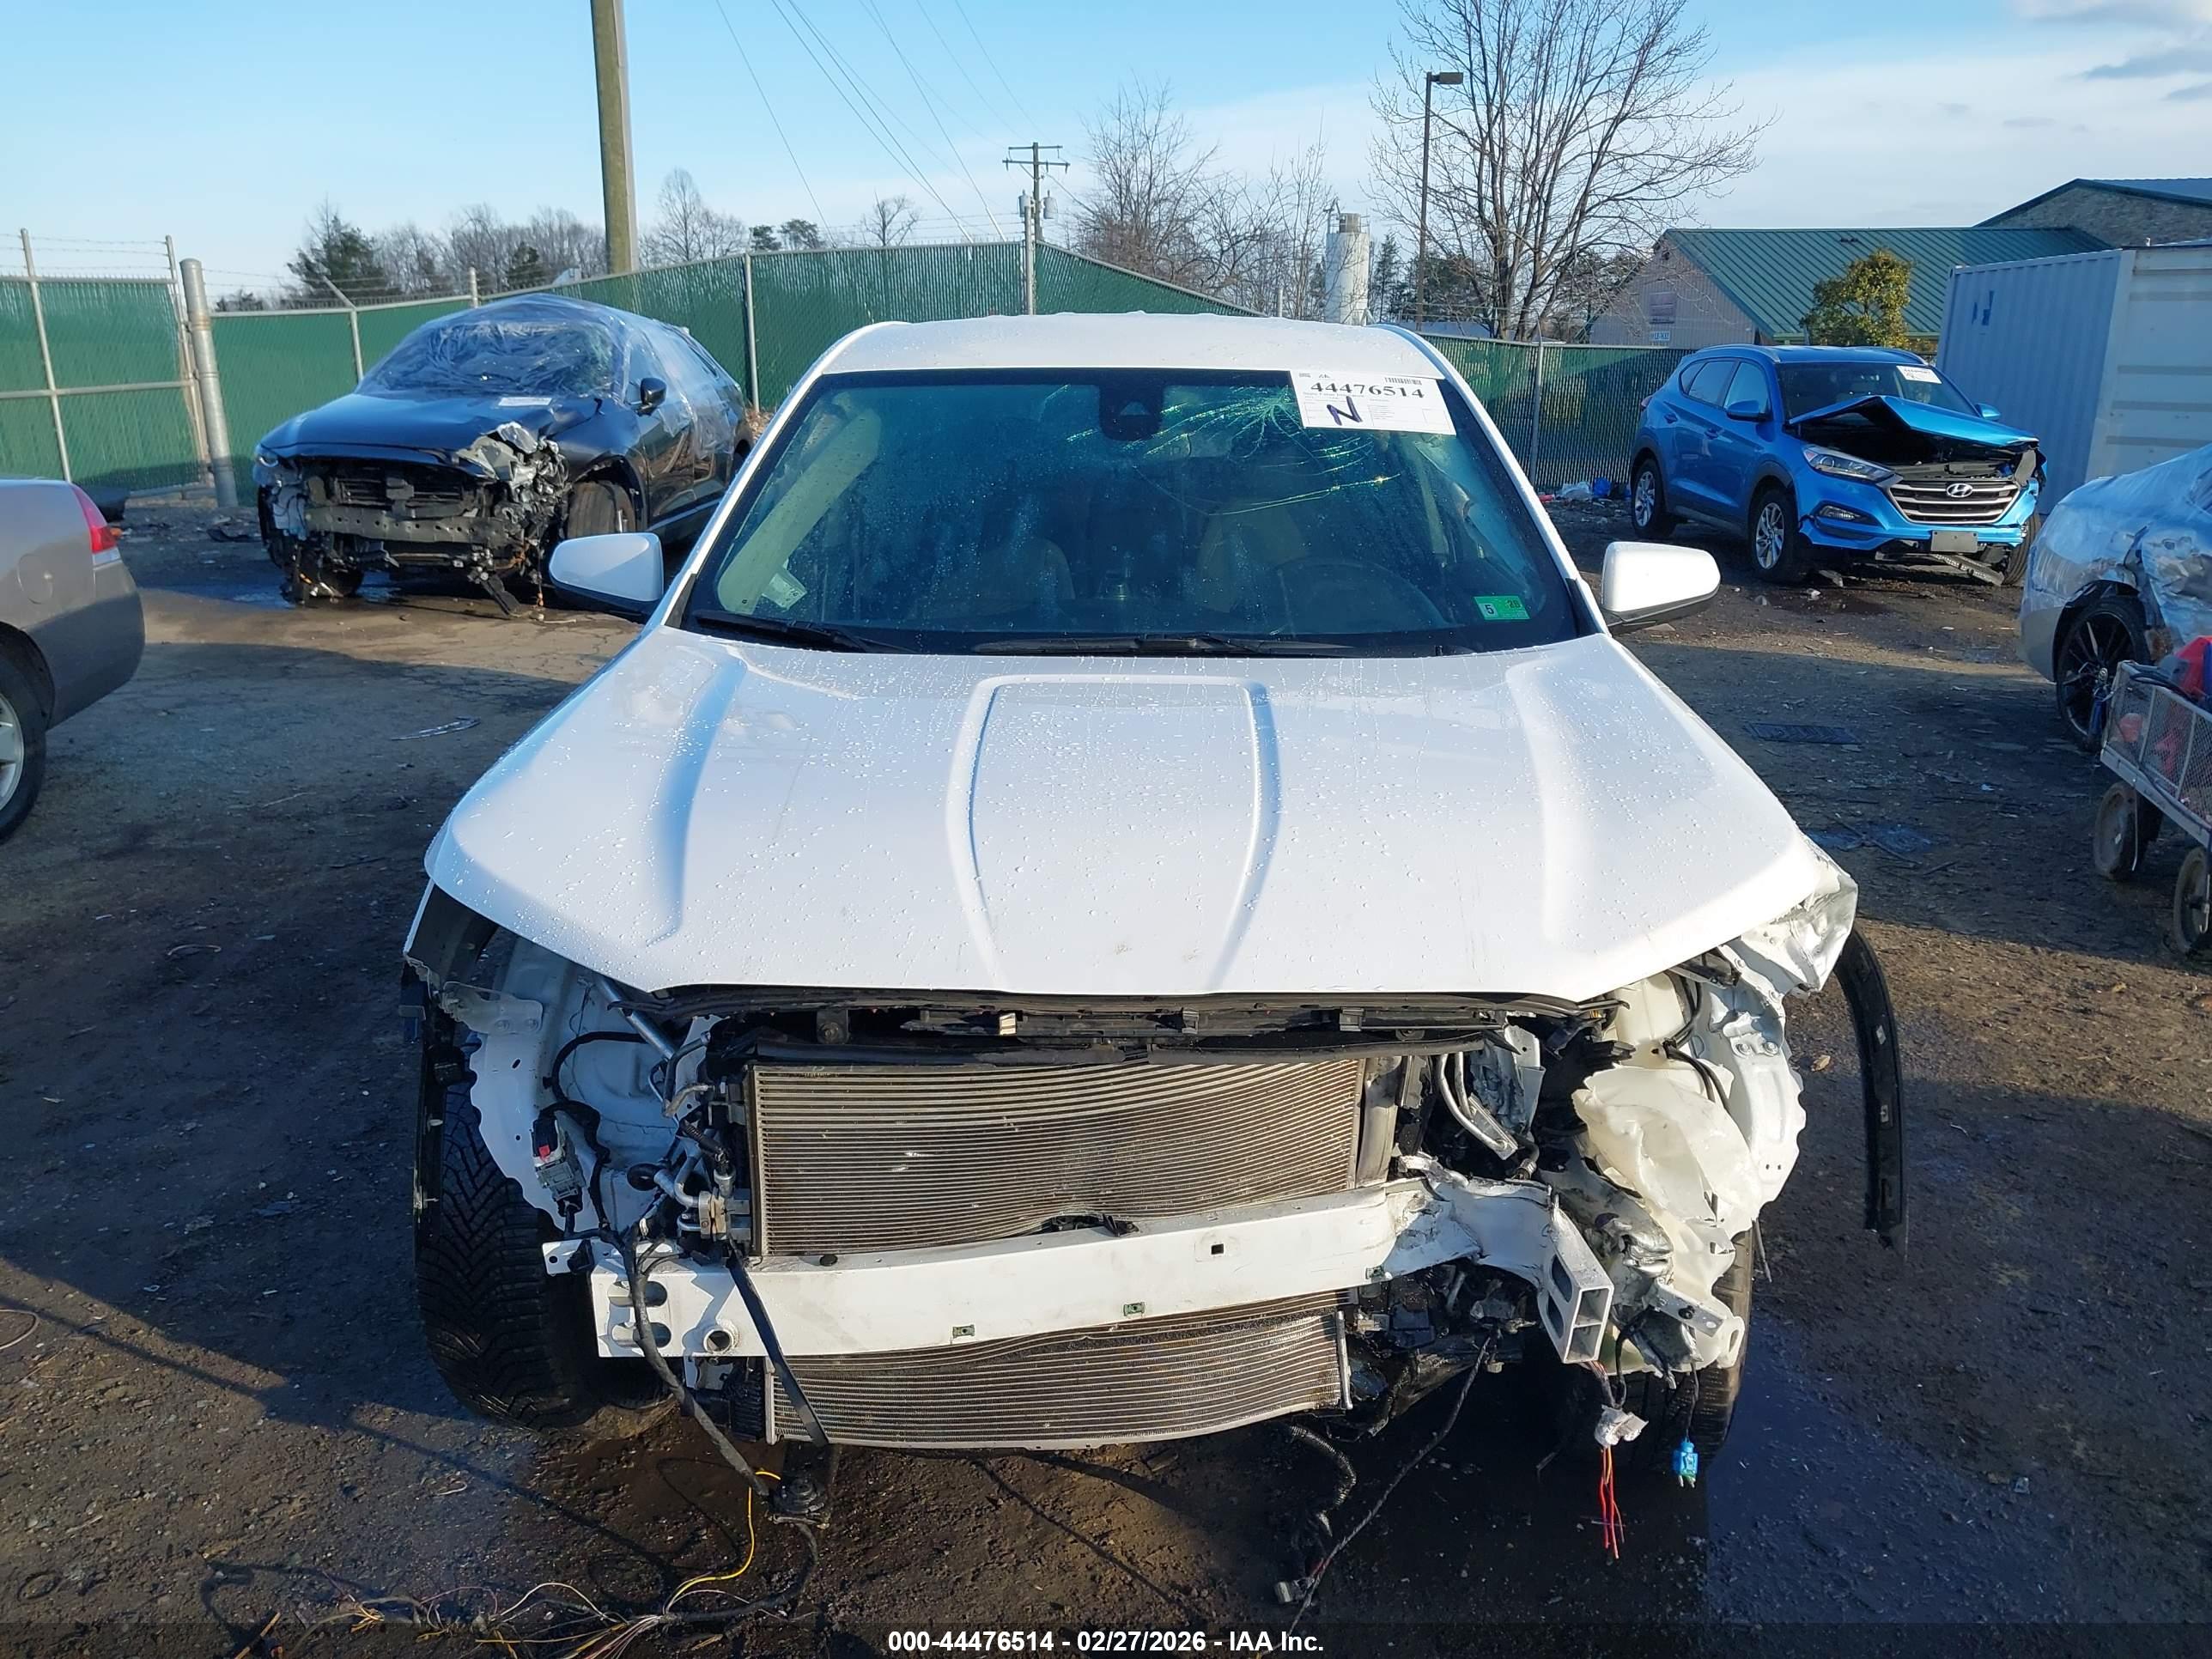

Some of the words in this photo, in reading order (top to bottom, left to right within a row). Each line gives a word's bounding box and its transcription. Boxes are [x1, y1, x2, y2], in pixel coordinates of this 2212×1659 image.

[1310, 382, 1425, 398] 44476514
[1326, 396, 1363, 426] N
[1485, 604, 1495, 615] 5
